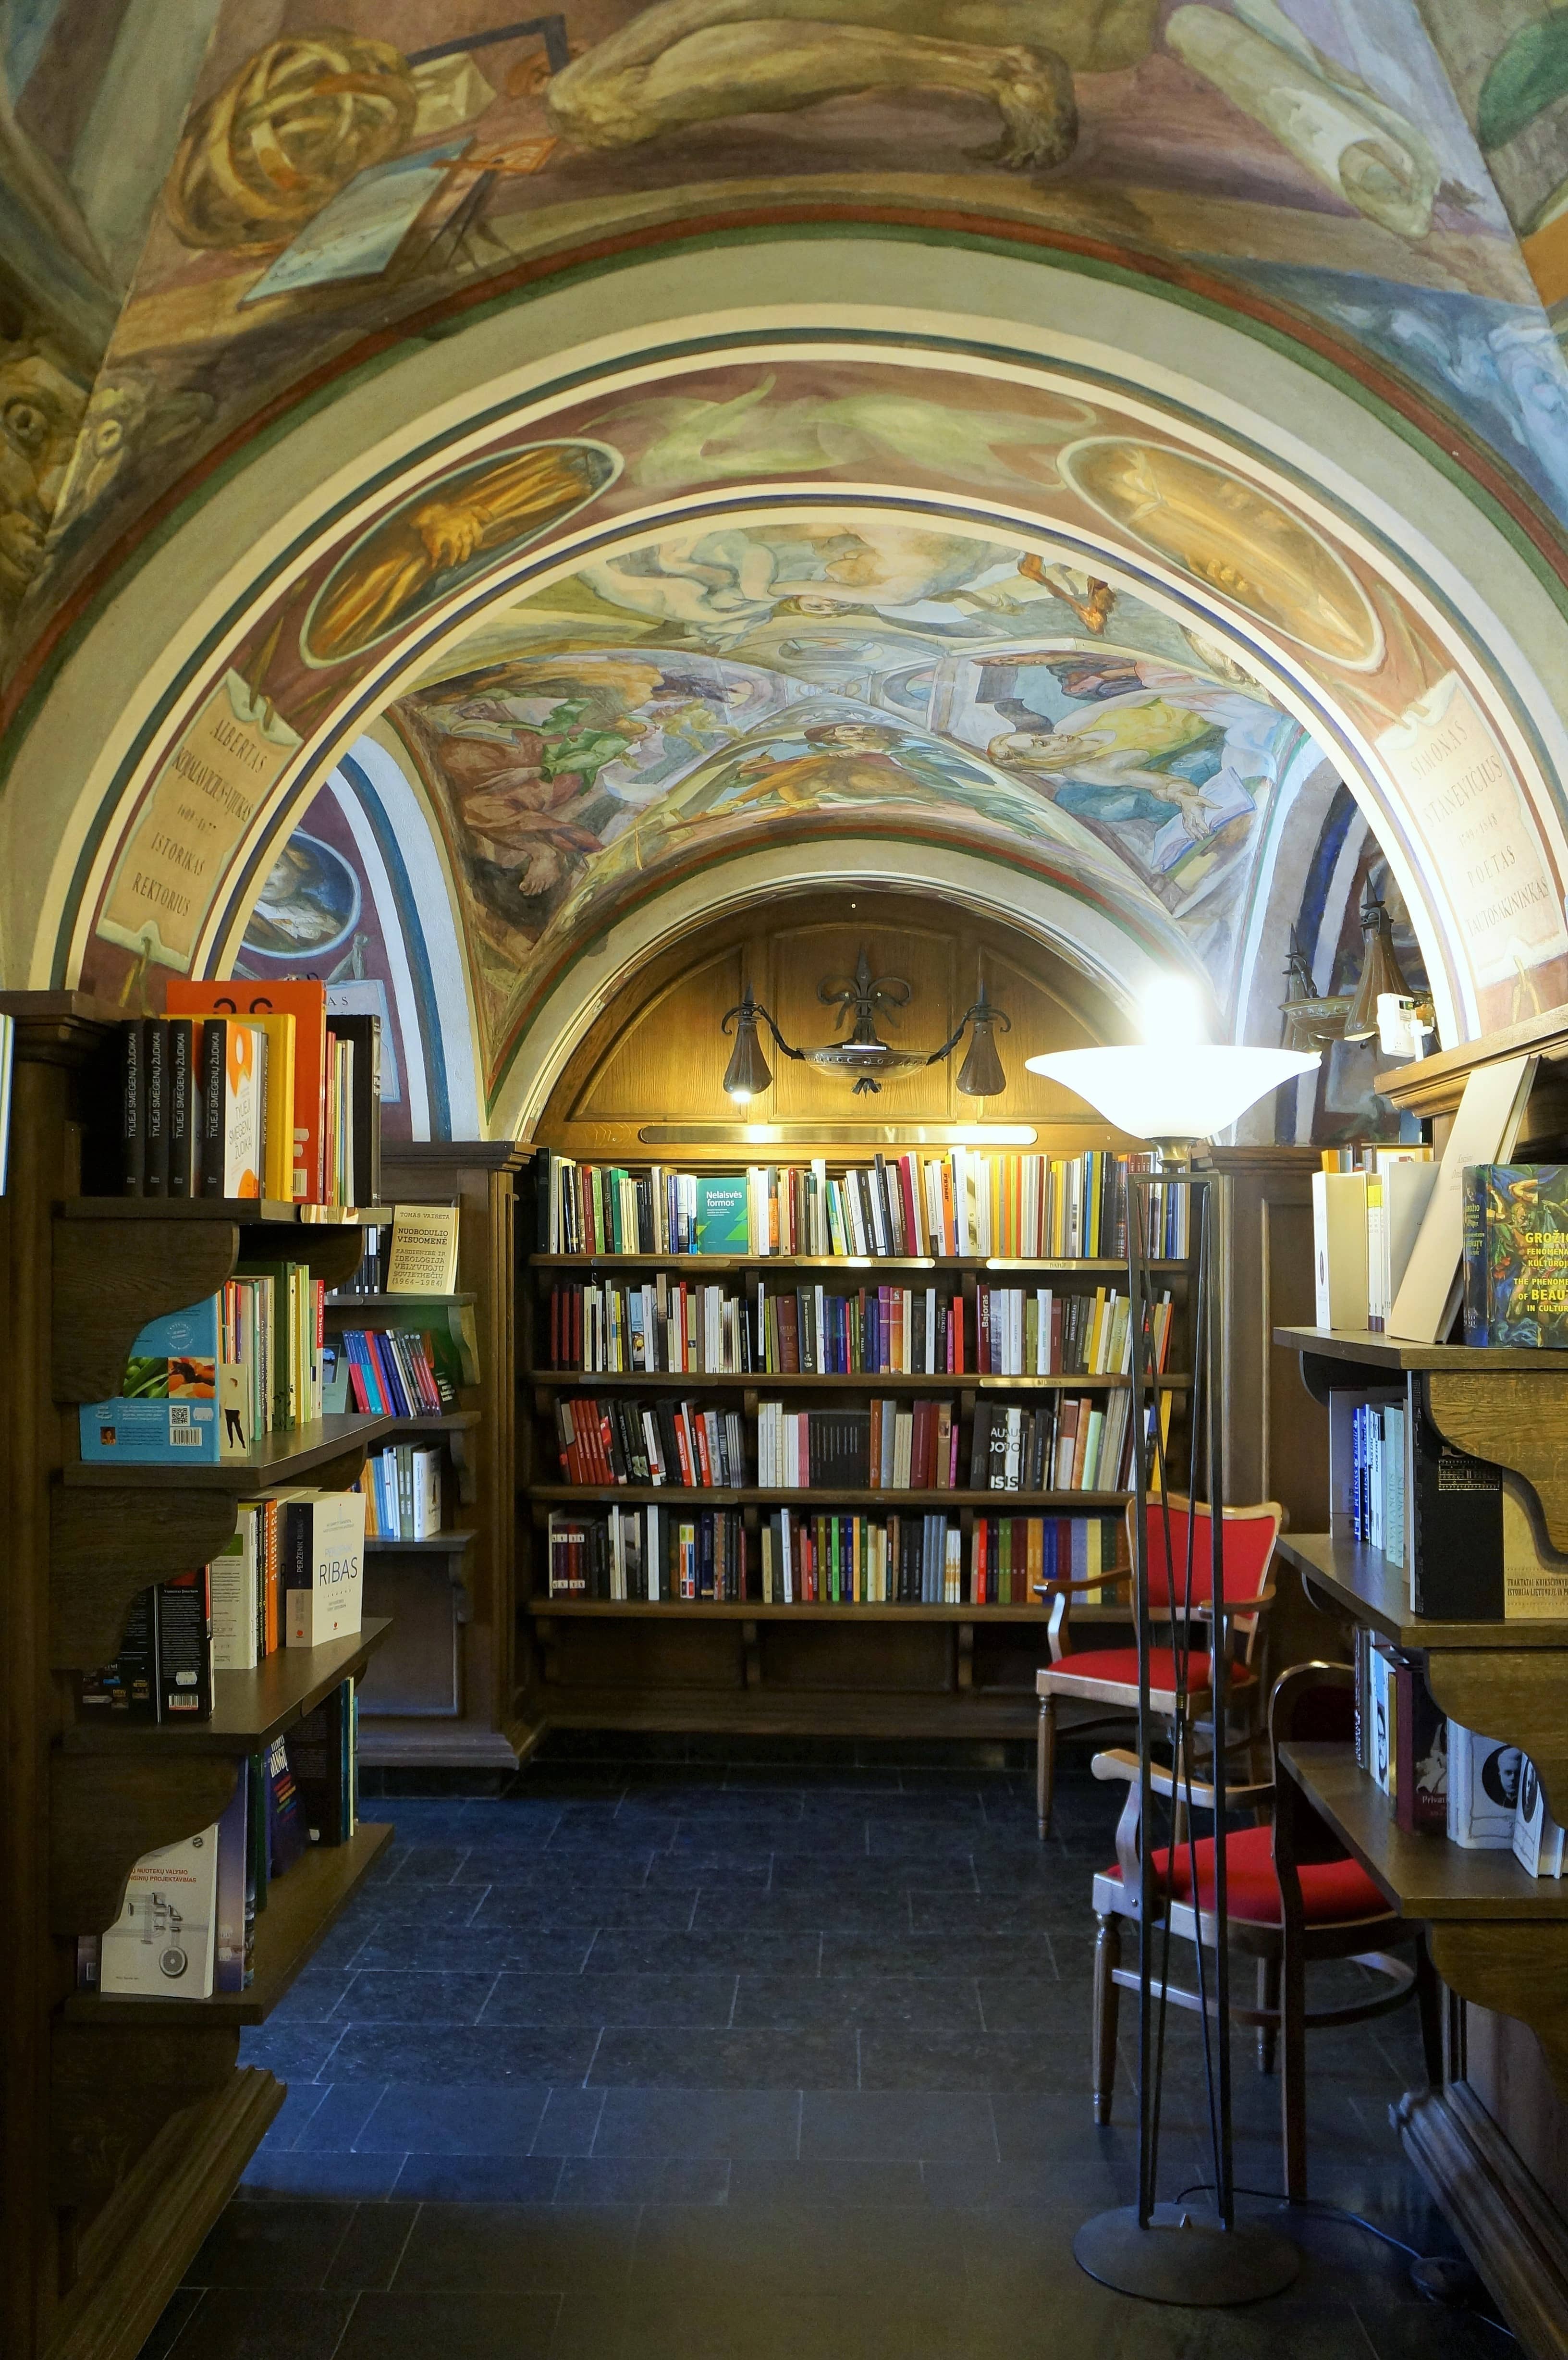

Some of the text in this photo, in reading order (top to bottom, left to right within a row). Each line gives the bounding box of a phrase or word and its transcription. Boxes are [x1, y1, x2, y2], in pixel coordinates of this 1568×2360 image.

[210, 719, 267, 773] ALBERTAS
[1411, 720, 1468, 779] SIMONAS
[151, 832, 205, 876] ISTORIKAS
[1467, 845, 1516, 888] POETAS
[133, 872, 191, 917] REKTORIUS
[1466, 876, 1549, 937] TAUTOSAKININKAS
[706, 1191, 742, 1199] Nelaisvės
[707, 1199, 735, 1207] formos
[397, 1236, 447, 1245] VISUOMENĖ
[398, 1228, 448, 1236] NUOBODULIO
[1525, 1230, 1568, 1243] GROŽI
[395, 1255, 445, 1264] IDEOLOGIJA
[295, 1541, 304, 1573] PERŽENK
[319, 1556, 358, 1586] RIBAS
